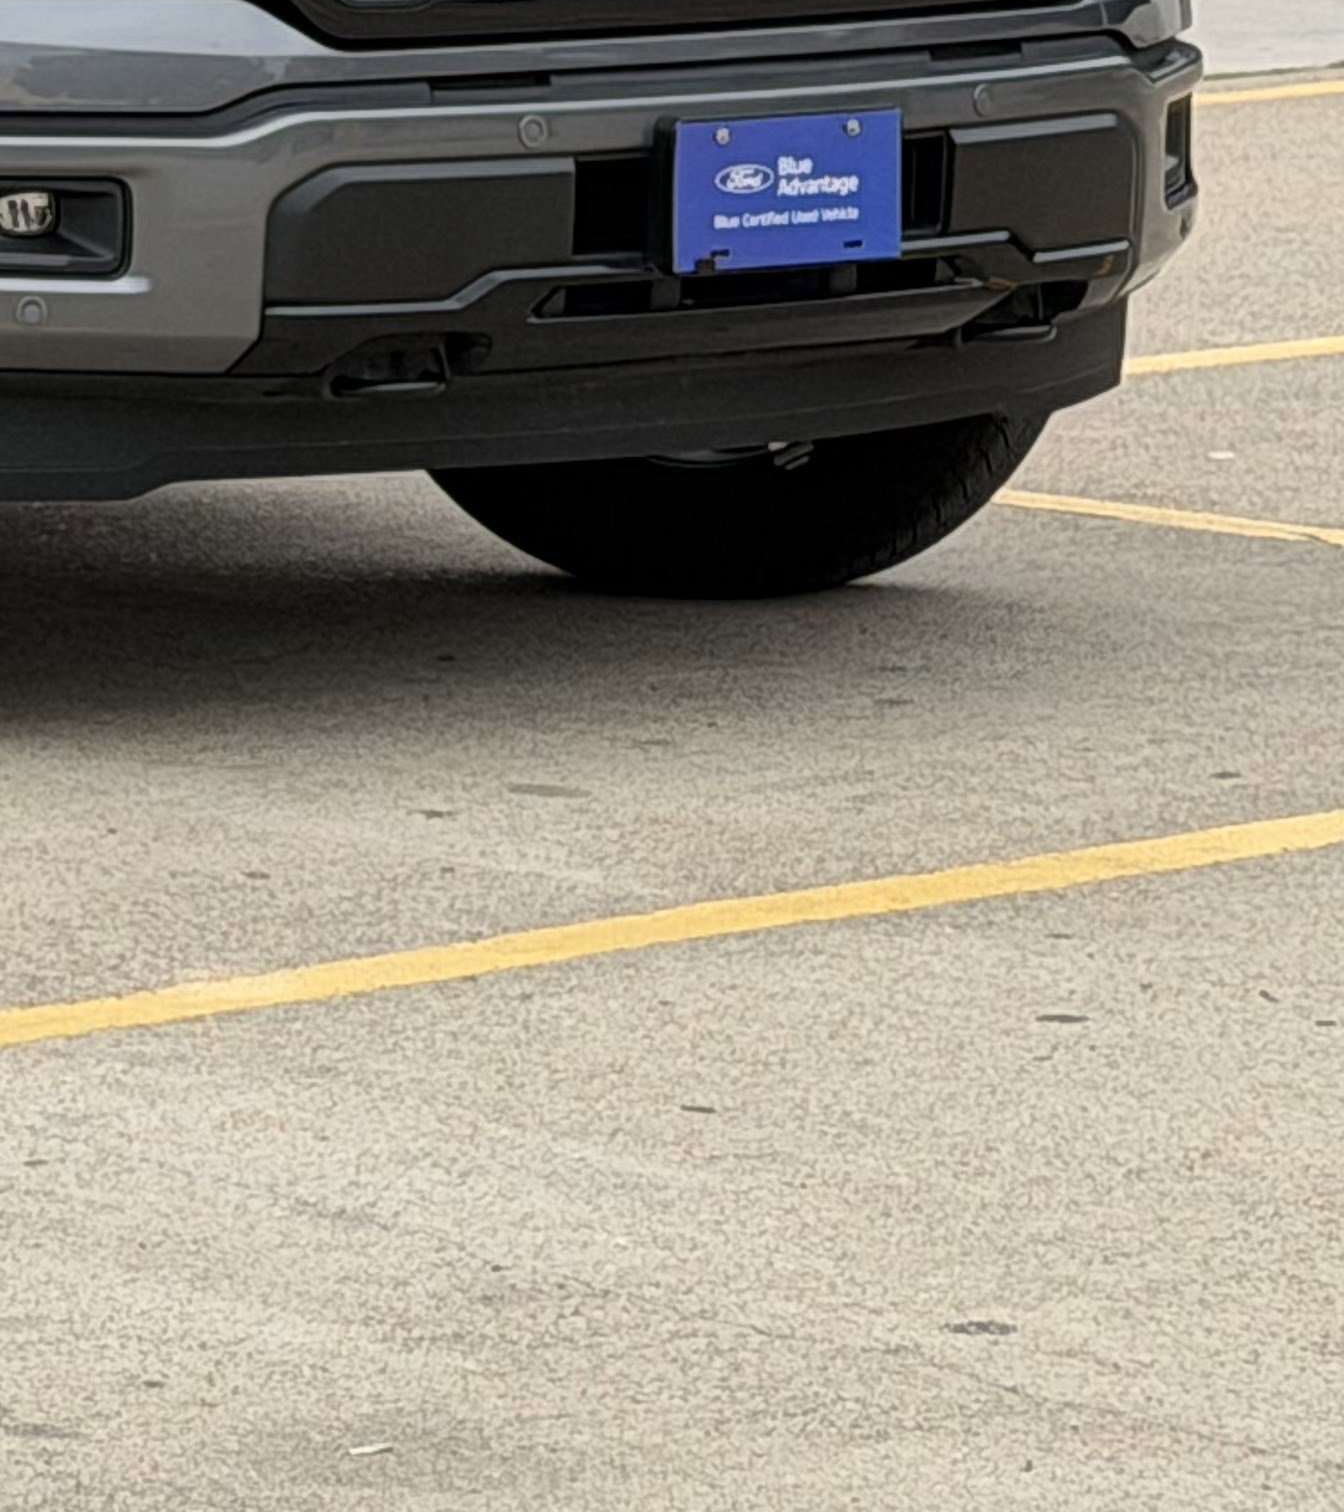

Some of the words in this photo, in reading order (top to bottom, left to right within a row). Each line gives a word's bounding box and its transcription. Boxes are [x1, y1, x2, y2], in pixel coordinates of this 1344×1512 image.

[778, 156, 812, 175] Blue
[777, 174, 859, 196] Advantage
[714, 214, 740, 229] Blue
[742, 211, 789, 228] Certified
[791, 208, 819, 224] Used
[820, 205, 859, 221] Vehicle
